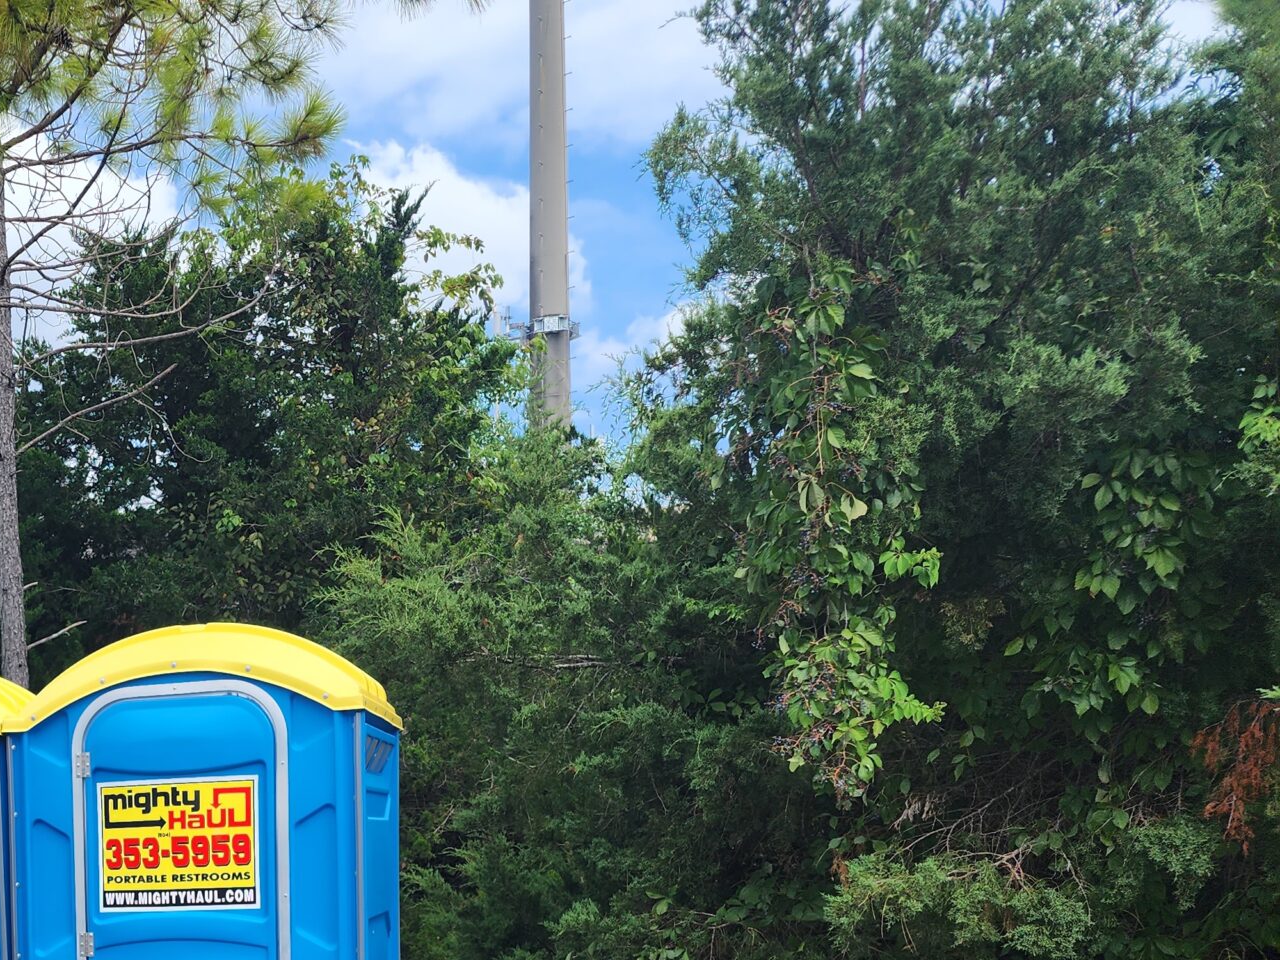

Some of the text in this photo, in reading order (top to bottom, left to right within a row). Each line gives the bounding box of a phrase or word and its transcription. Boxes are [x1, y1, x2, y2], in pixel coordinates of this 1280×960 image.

[104, 787, 200, 814] mighty
[106, 834, 251, 870] 353-5959
[107, 872, 251, 884] PORTABLE RESTROOMS
[105, 888, 254, 906] WWW.MIGHTYHAUL.COM
